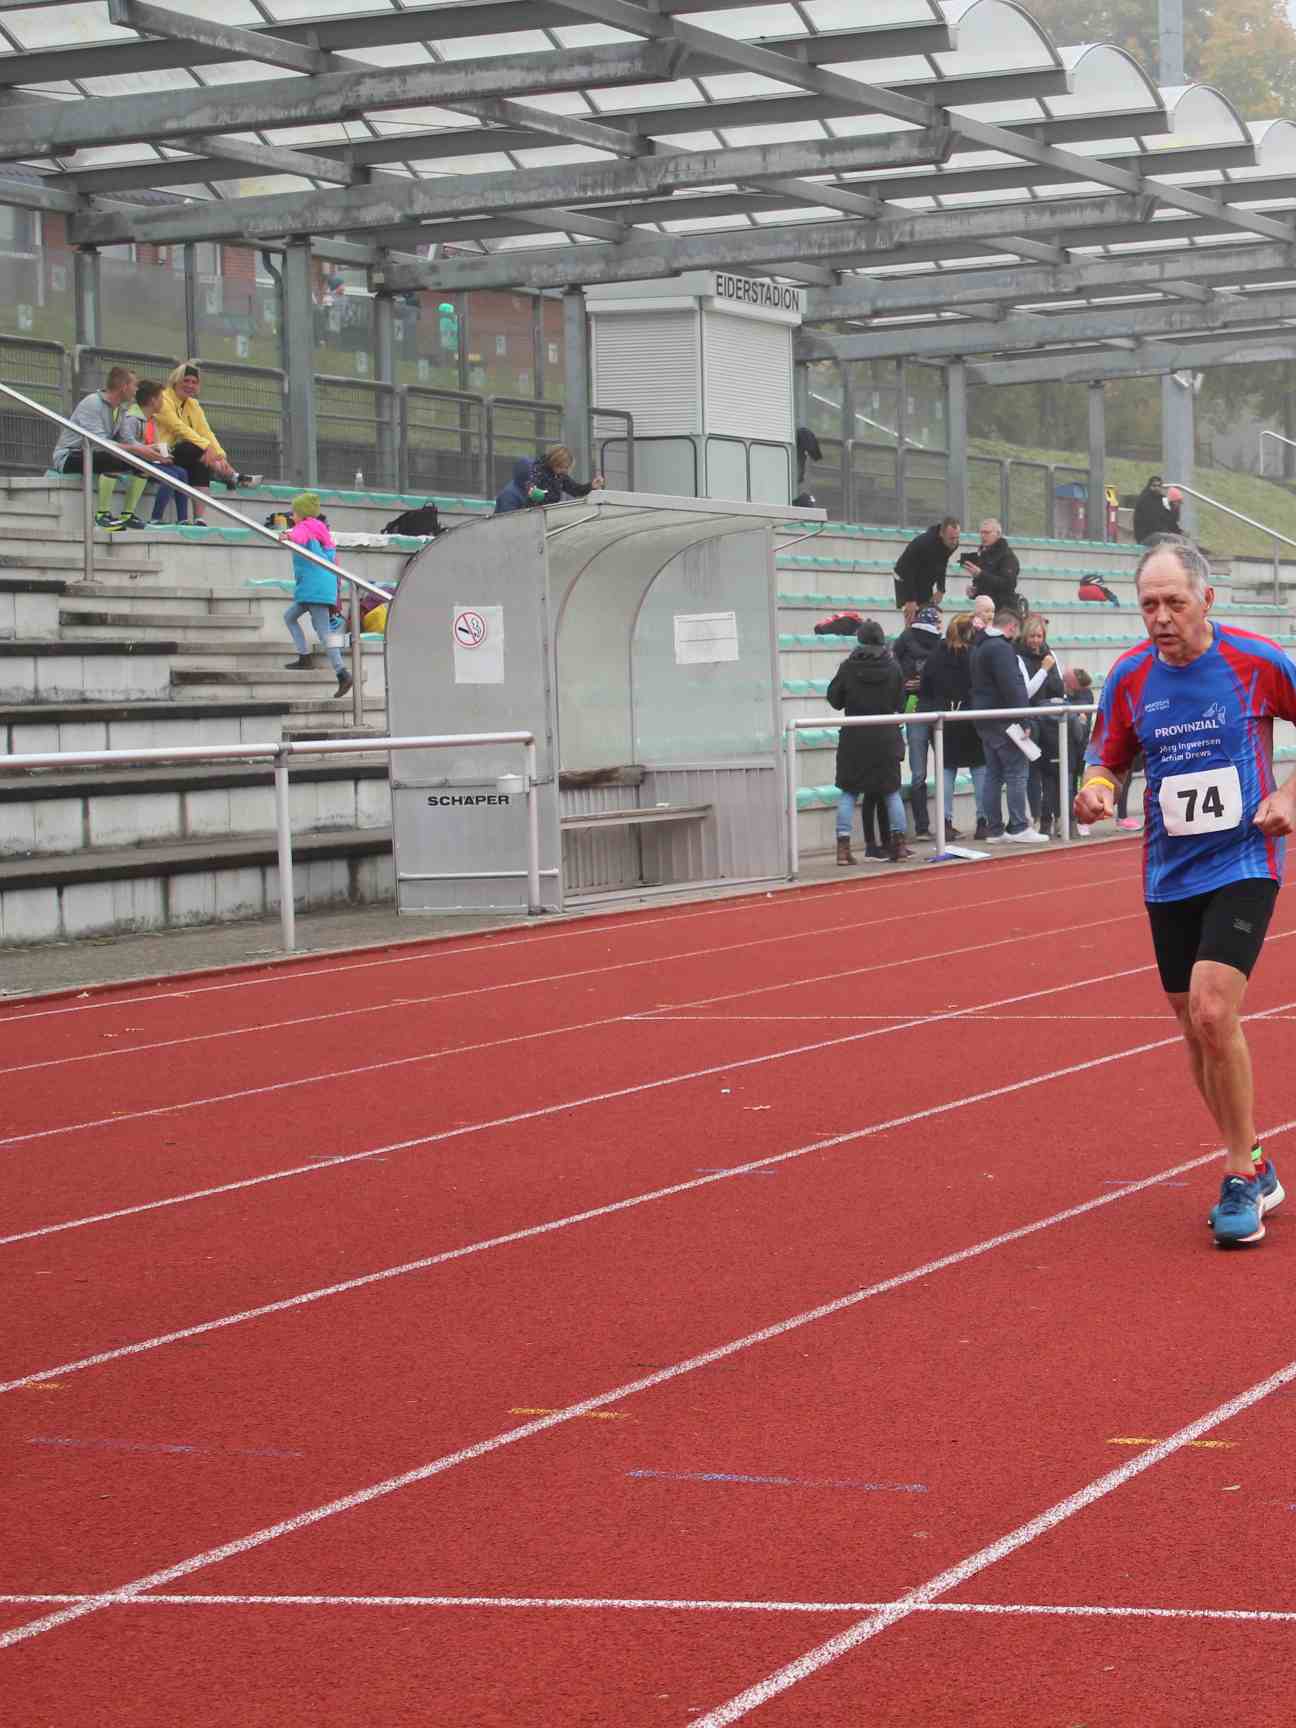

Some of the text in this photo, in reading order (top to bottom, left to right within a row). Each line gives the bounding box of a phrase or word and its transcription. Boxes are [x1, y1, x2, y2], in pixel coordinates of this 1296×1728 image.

[716, 275, 799, 311] EIDERSTADION
[1154, 720, 1219, 738] PROVINZIAL
[1177, 786, 1225, 822] 74
